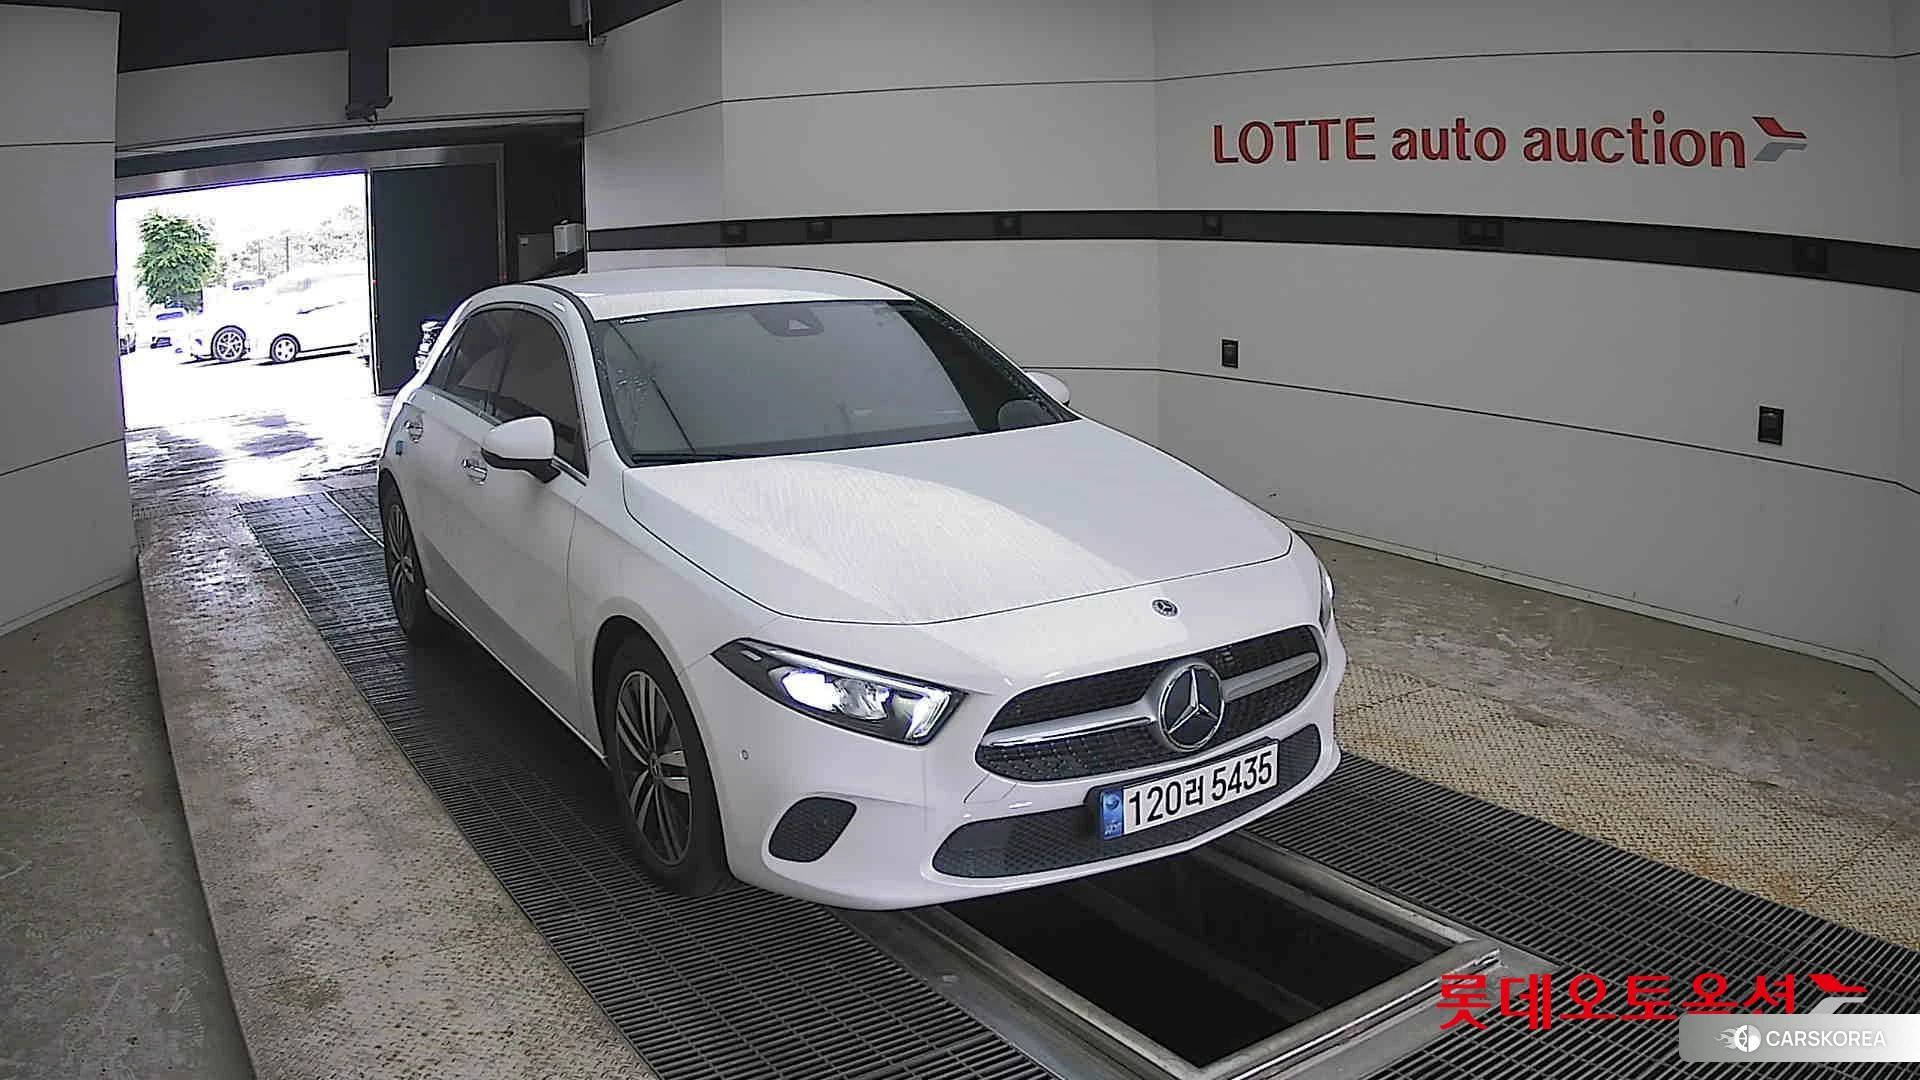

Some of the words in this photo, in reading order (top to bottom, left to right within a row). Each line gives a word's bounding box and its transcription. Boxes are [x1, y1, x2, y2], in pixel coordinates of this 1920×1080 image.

[1213, 116, 1376, 164] LOTTE
[1391, 117, 1507, 162] auto
[1522, 109, 1746, 168] auction
[1211, 750, 1273, 801] 5435
